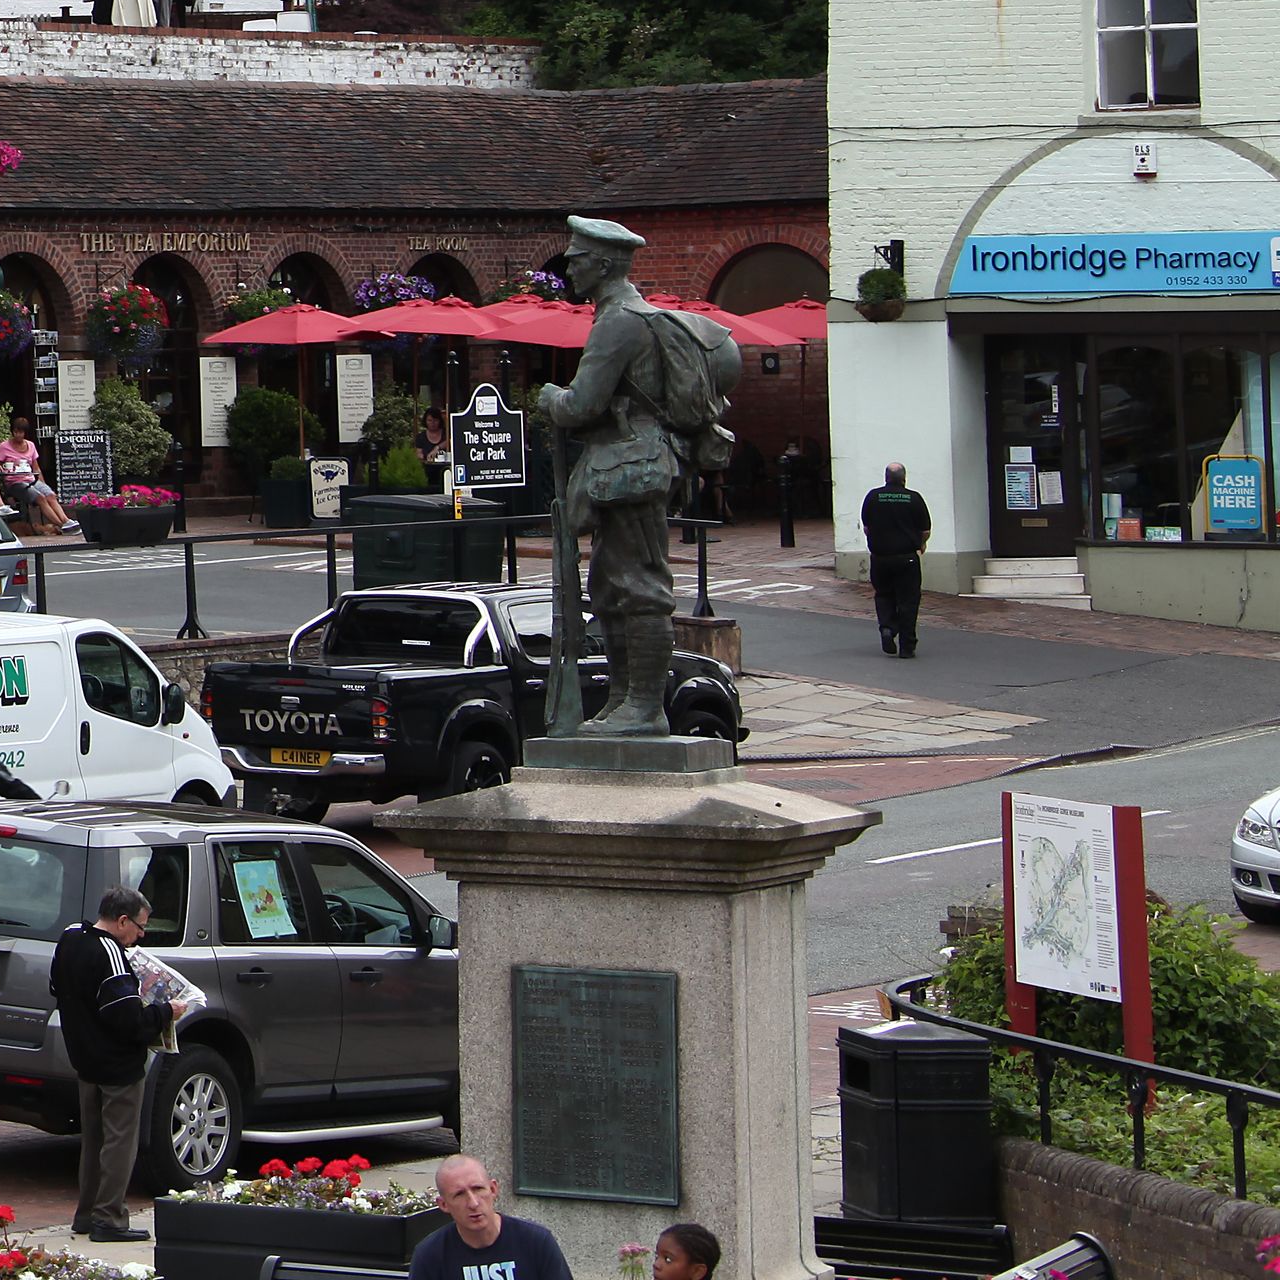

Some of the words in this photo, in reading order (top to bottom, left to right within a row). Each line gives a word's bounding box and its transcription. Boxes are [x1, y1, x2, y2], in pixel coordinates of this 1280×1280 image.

[80, 233, 115, 252] THE
[123, 233, 156, 252] TEA
[162, 233, 251, 252] EMPORIUM
[408, 236, 430, 250] TEA
[436, 236, 468, 250] ROOM
[971, 244, 1127, 277] Ironbridge
[1135, 247, 1260, 273] Pharmacy
[1166, 276, 1199, 286] 01952
[1203, 275, 1224, 285] 433
[1227, 275, 1248, 285] 330
[474, 421, 494, 429] Welcome
[60, 435, 104, 444] EMPORIUM
[464, 431, 479, 445] The
[482, 431, 512, 445] Square
[469, 449, 485, 462] Car
[487, 447, 506, 461] Park
[1213, 474, 1256, 487] CASH
[1213, 487, 1256, 495] MACHINE
[1213, 495, 1256, 509] HERE
[239, 709, 343, 736] TOYOTA
